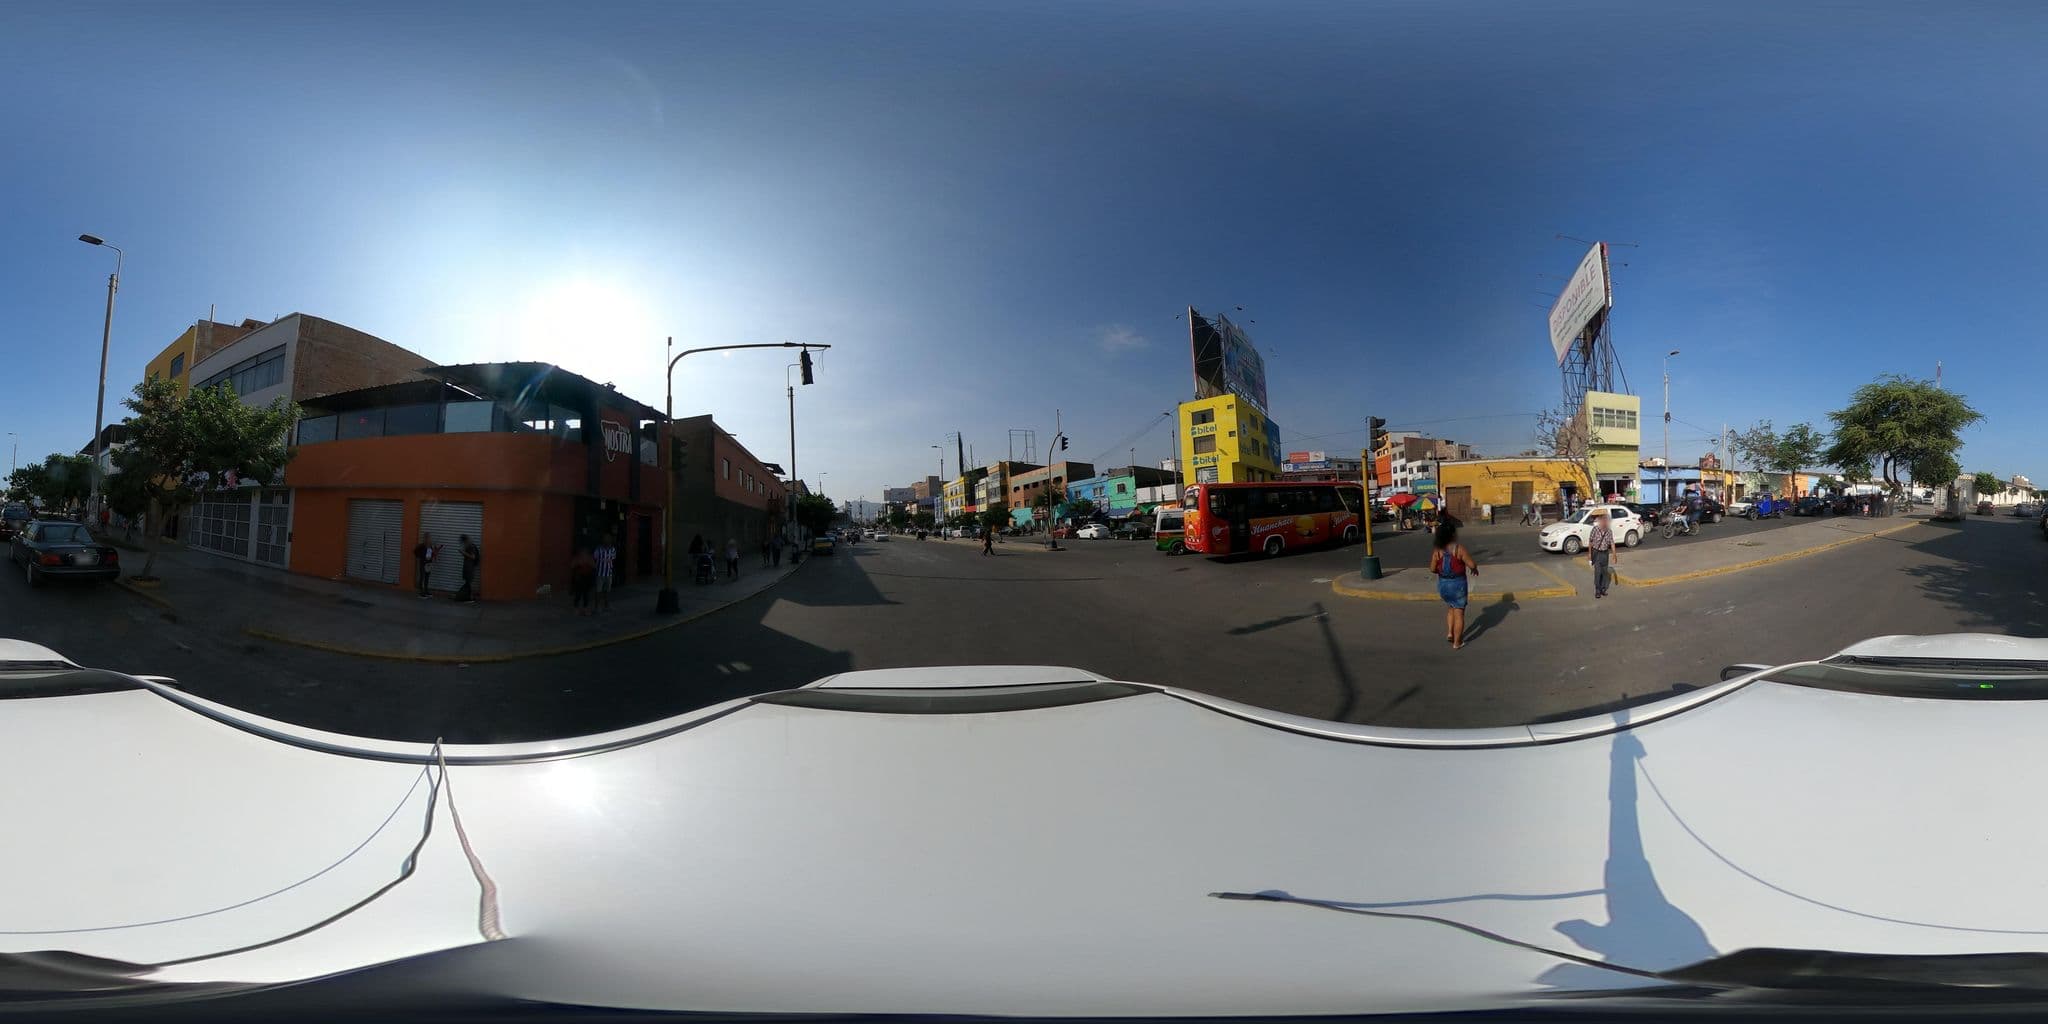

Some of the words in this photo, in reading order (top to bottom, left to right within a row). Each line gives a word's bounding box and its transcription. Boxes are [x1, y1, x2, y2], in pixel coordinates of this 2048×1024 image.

[1552, 263, 1597, 332] DISPONIBLE
[1197, 424, 1217, 435] bitel
[604, 428, 633, 455] NOSTRA
[1199, 455, 1219, 465] bitel
